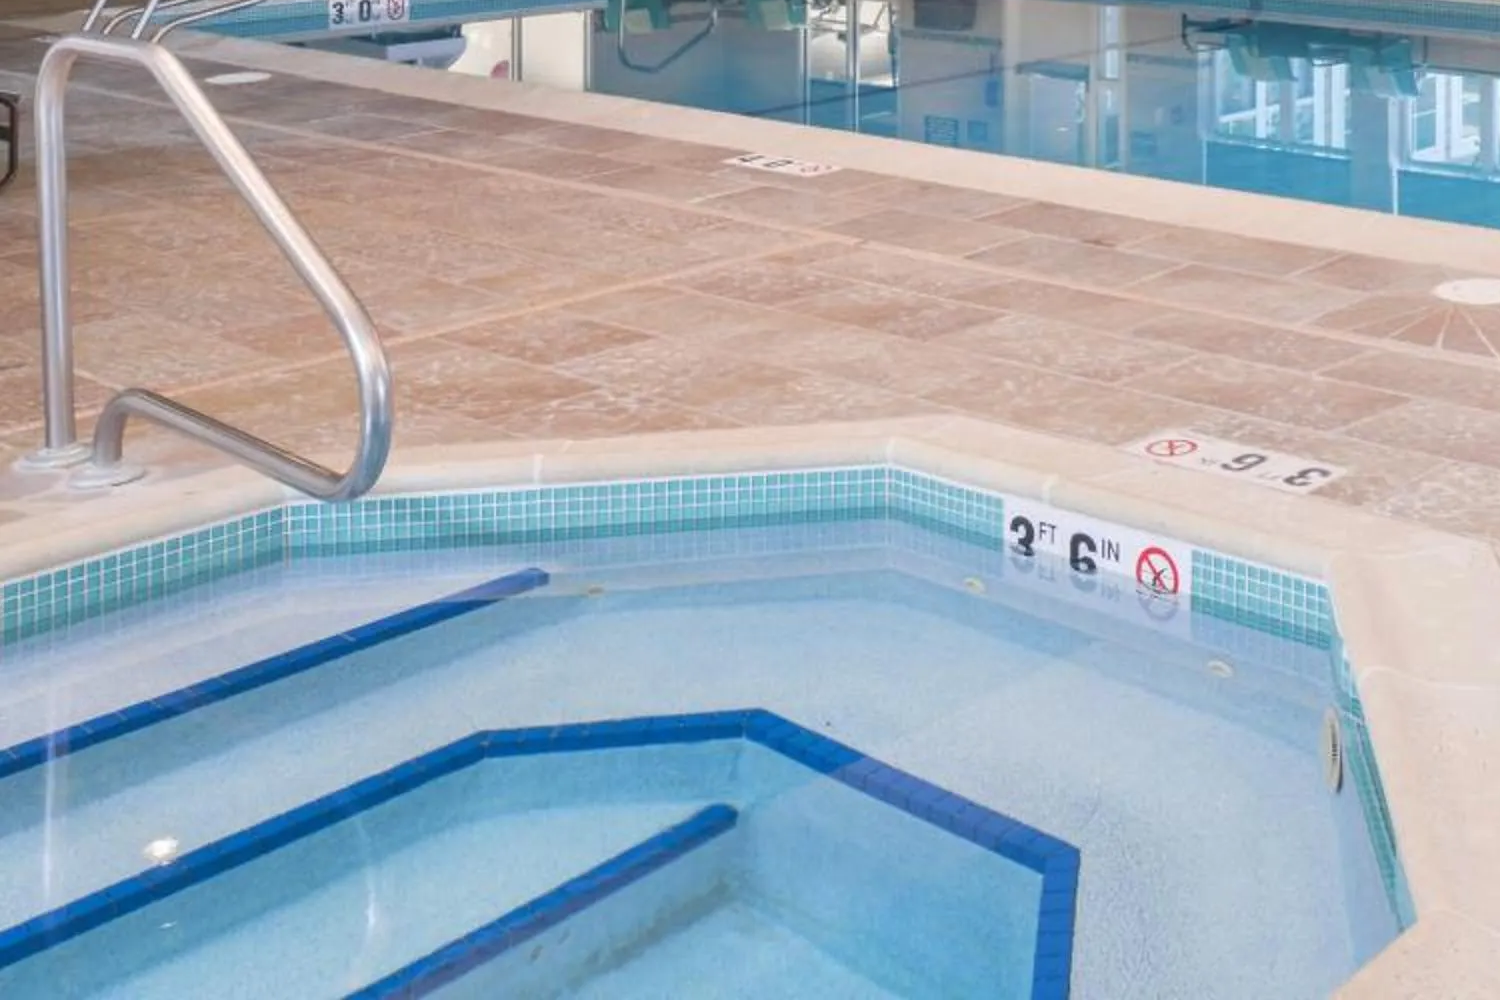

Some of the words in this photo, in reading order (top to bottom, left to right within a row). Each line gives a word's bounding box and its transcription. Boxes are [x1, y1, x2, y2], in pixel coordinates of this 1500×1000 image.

[359, 0, 371, 21] 0
[1220, 453, 1268, 472] 6
[1283, 467, 1333, 487] 3
[1010, 515, 1035, 557] 3
[1039, 522, 1057, 545] FT
[1069, 533, 1098, 575] 6
[1101, 538, 1121, 563] IN
